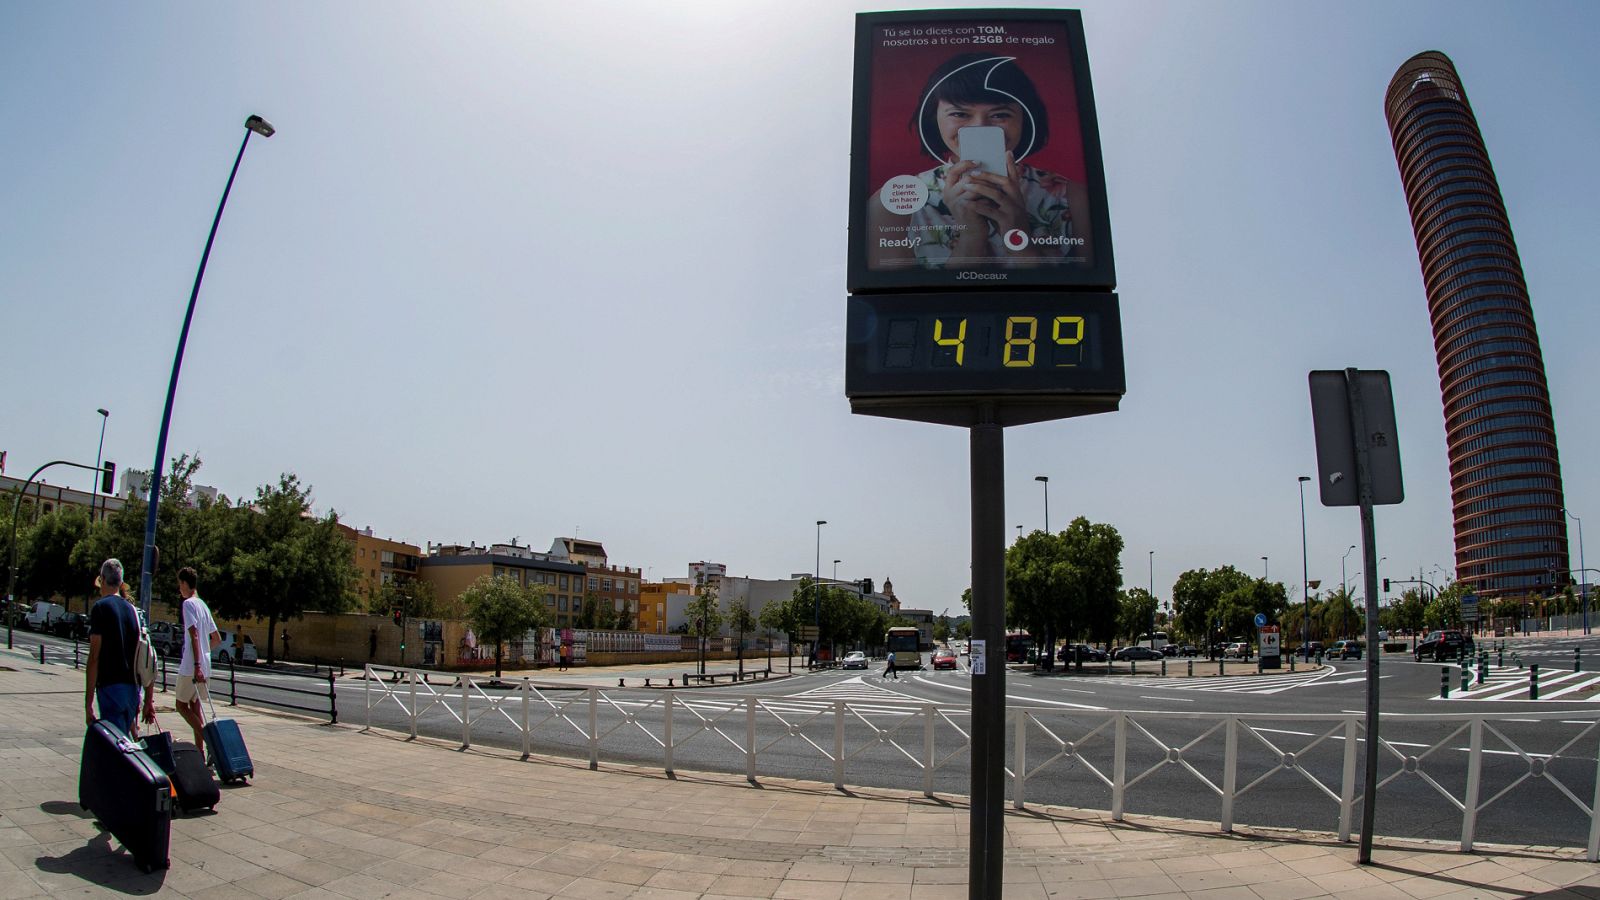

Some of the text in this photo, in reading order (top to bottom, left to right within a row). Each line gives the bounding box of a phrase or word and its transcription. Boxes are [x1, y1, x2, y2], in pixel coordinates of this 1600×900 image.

[883, 28, 896, 37] Tú
[899, 29, 911, 37] se
[913, 28, 923, 36] lo
[926, 27, 953, 36] dices
[955, 27, 975, 35] con
[883, 38, 929, 47] nosotros
[940, 37, 948, 45] ti
[950, 37, 970, 45] con
[972, 35, 1003, 44] 25GB
[1005, 36, 1019, 44] de
[1021, 36, 1055, 46] regalo
[879, 225, 905, 233] Vamos
[879, 236, 922, 249] Ready?
[1031, 235, 1085, 246] vodafone
[956, 271, 1008, 280] JCDecaux
